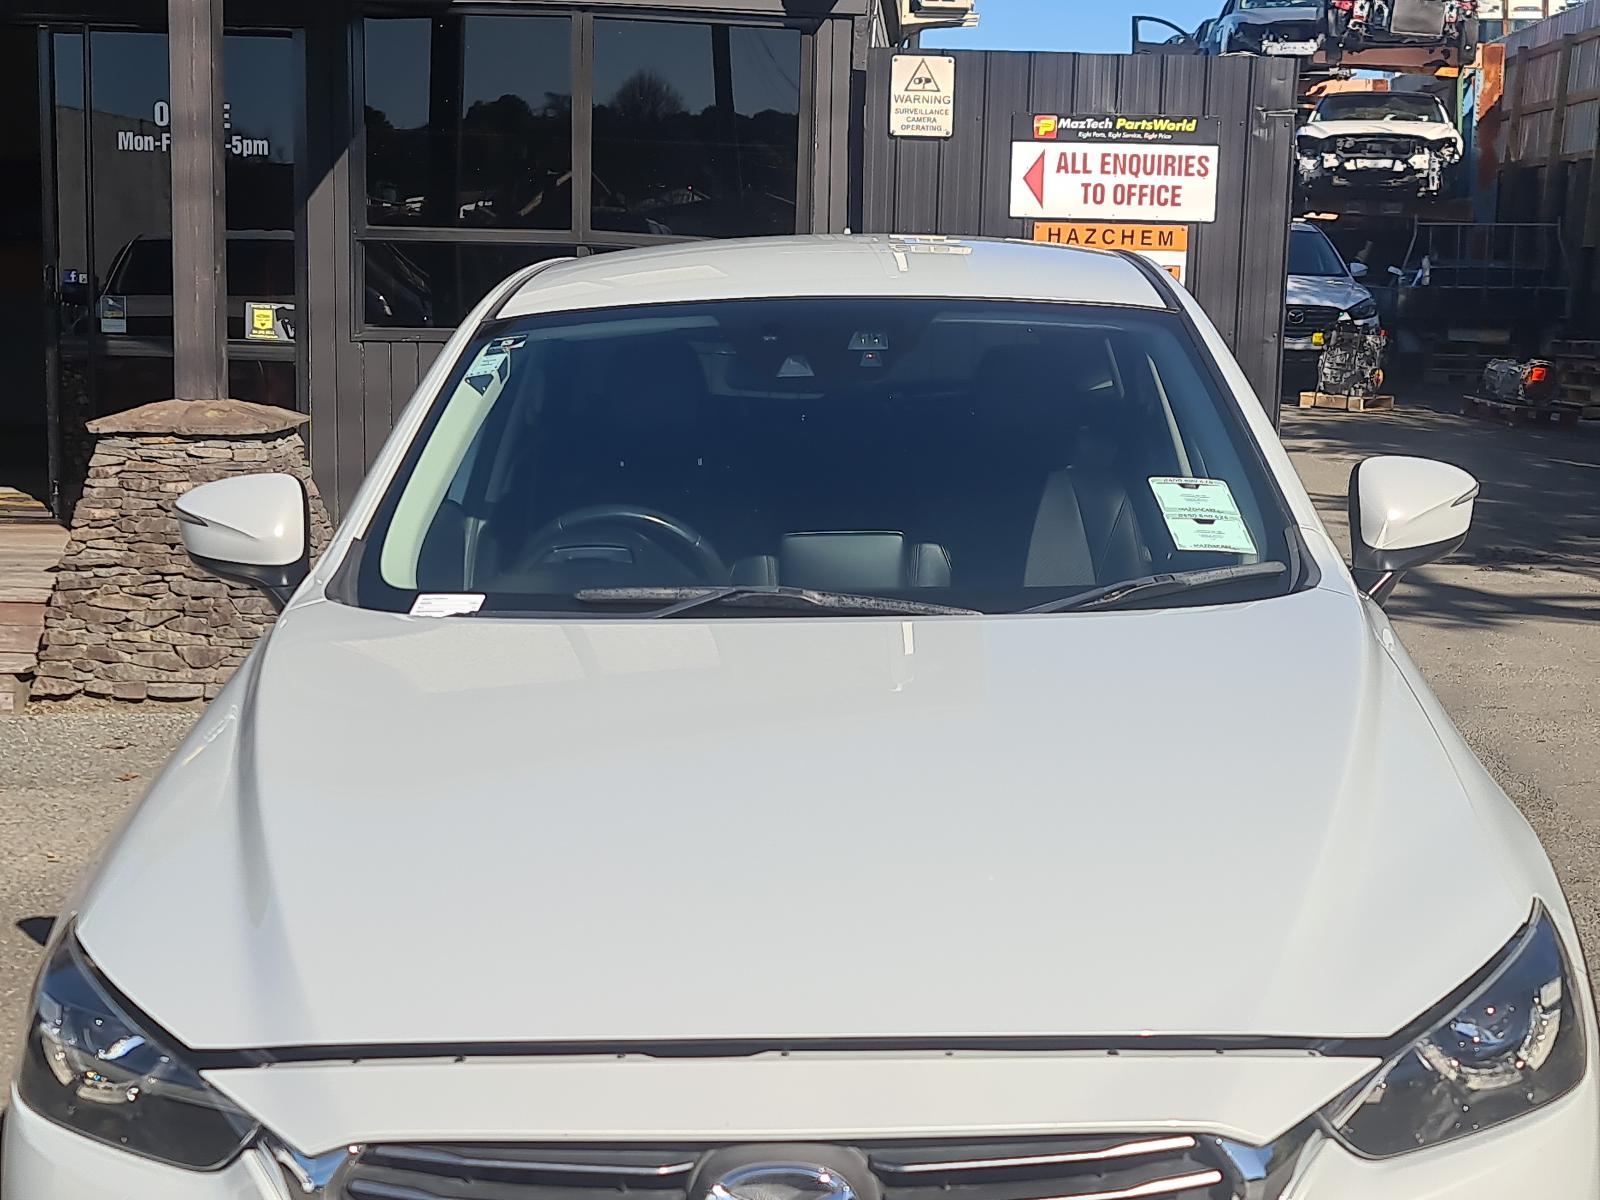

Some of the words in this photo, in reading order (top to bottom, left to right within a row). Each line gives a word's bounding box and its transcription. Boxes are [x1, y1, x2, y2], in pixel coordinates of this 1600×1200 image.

[894, 94, 951, 105] WARNING
[894, 107, 950, 115] SURVEILLANCE
[900, 124, 942, 132] OPERATING
[1058, 117, 1113, 129] MazTech
[1116, 118, 1197, 132] PartsWorld
[118, 131, 170, 151] Mon-F
[225, 135, 269, 157] -5pm
[1056, 151, 1092, 174] ALL
[1100, 152, 1210, 178] ENQUIRIES
[1081, 182, 1105, 205] TO
[1113, 184, 1182, 207] OFFICE
[1048, 227, 1174, 246] HAZCHEM
